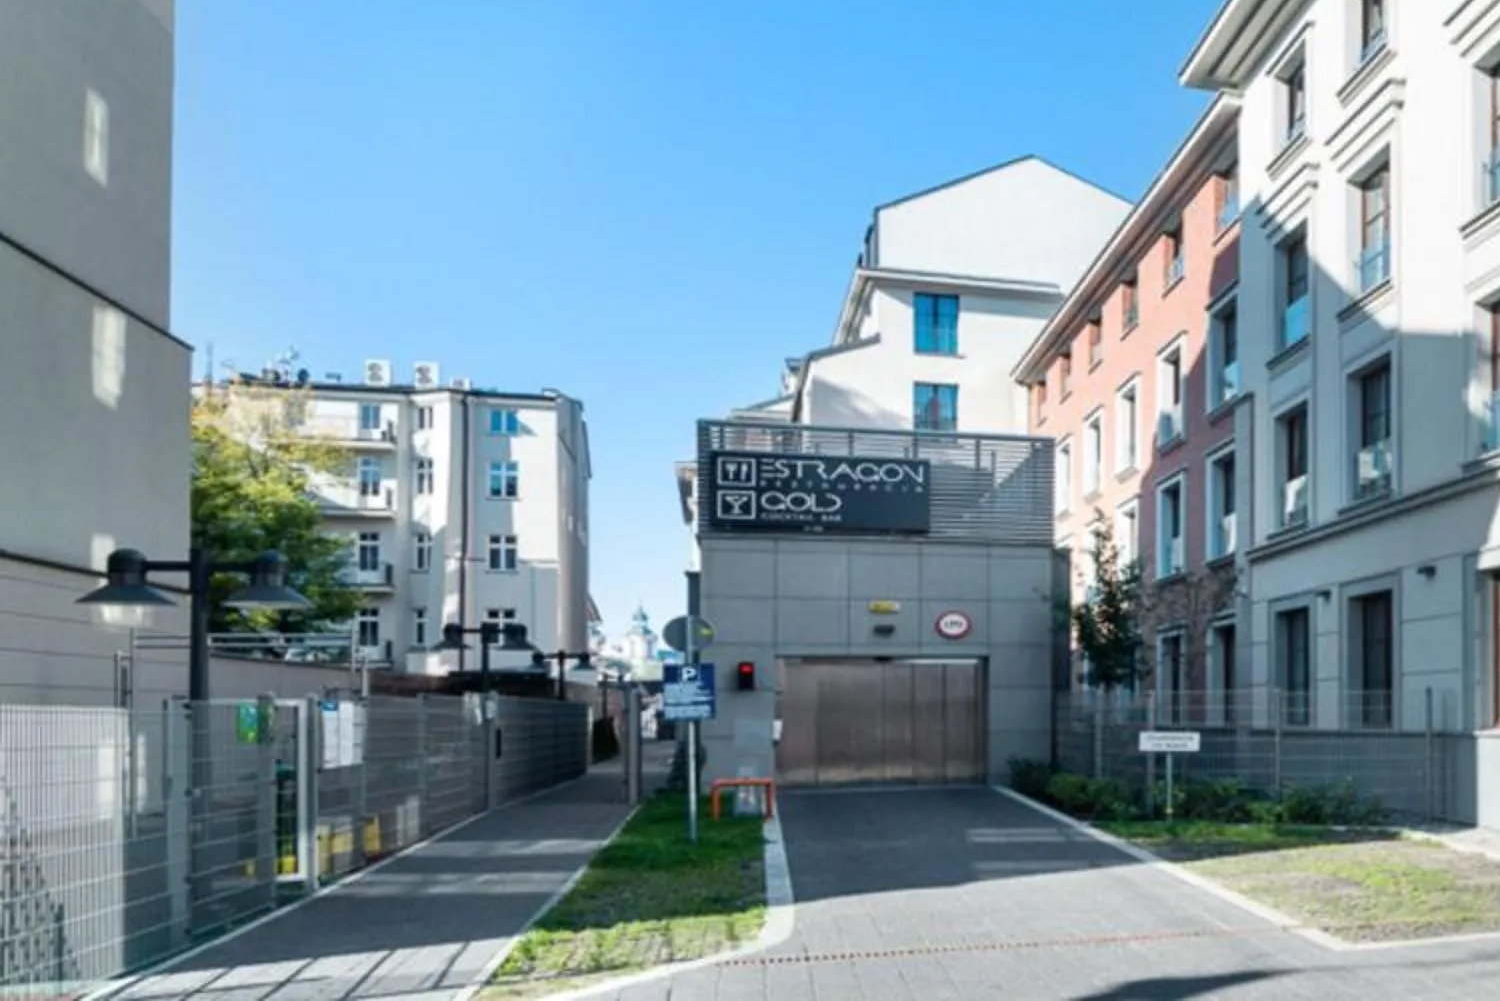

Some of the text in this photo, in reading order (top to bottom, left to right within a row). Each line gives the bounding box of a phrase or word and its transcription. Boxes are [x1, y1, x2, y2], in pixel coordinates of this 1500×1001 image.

[760, 457, 924, 483] ESTRAGON
[760, 490, 843, 512] GOLD
[681, 666, 697, 682] P
